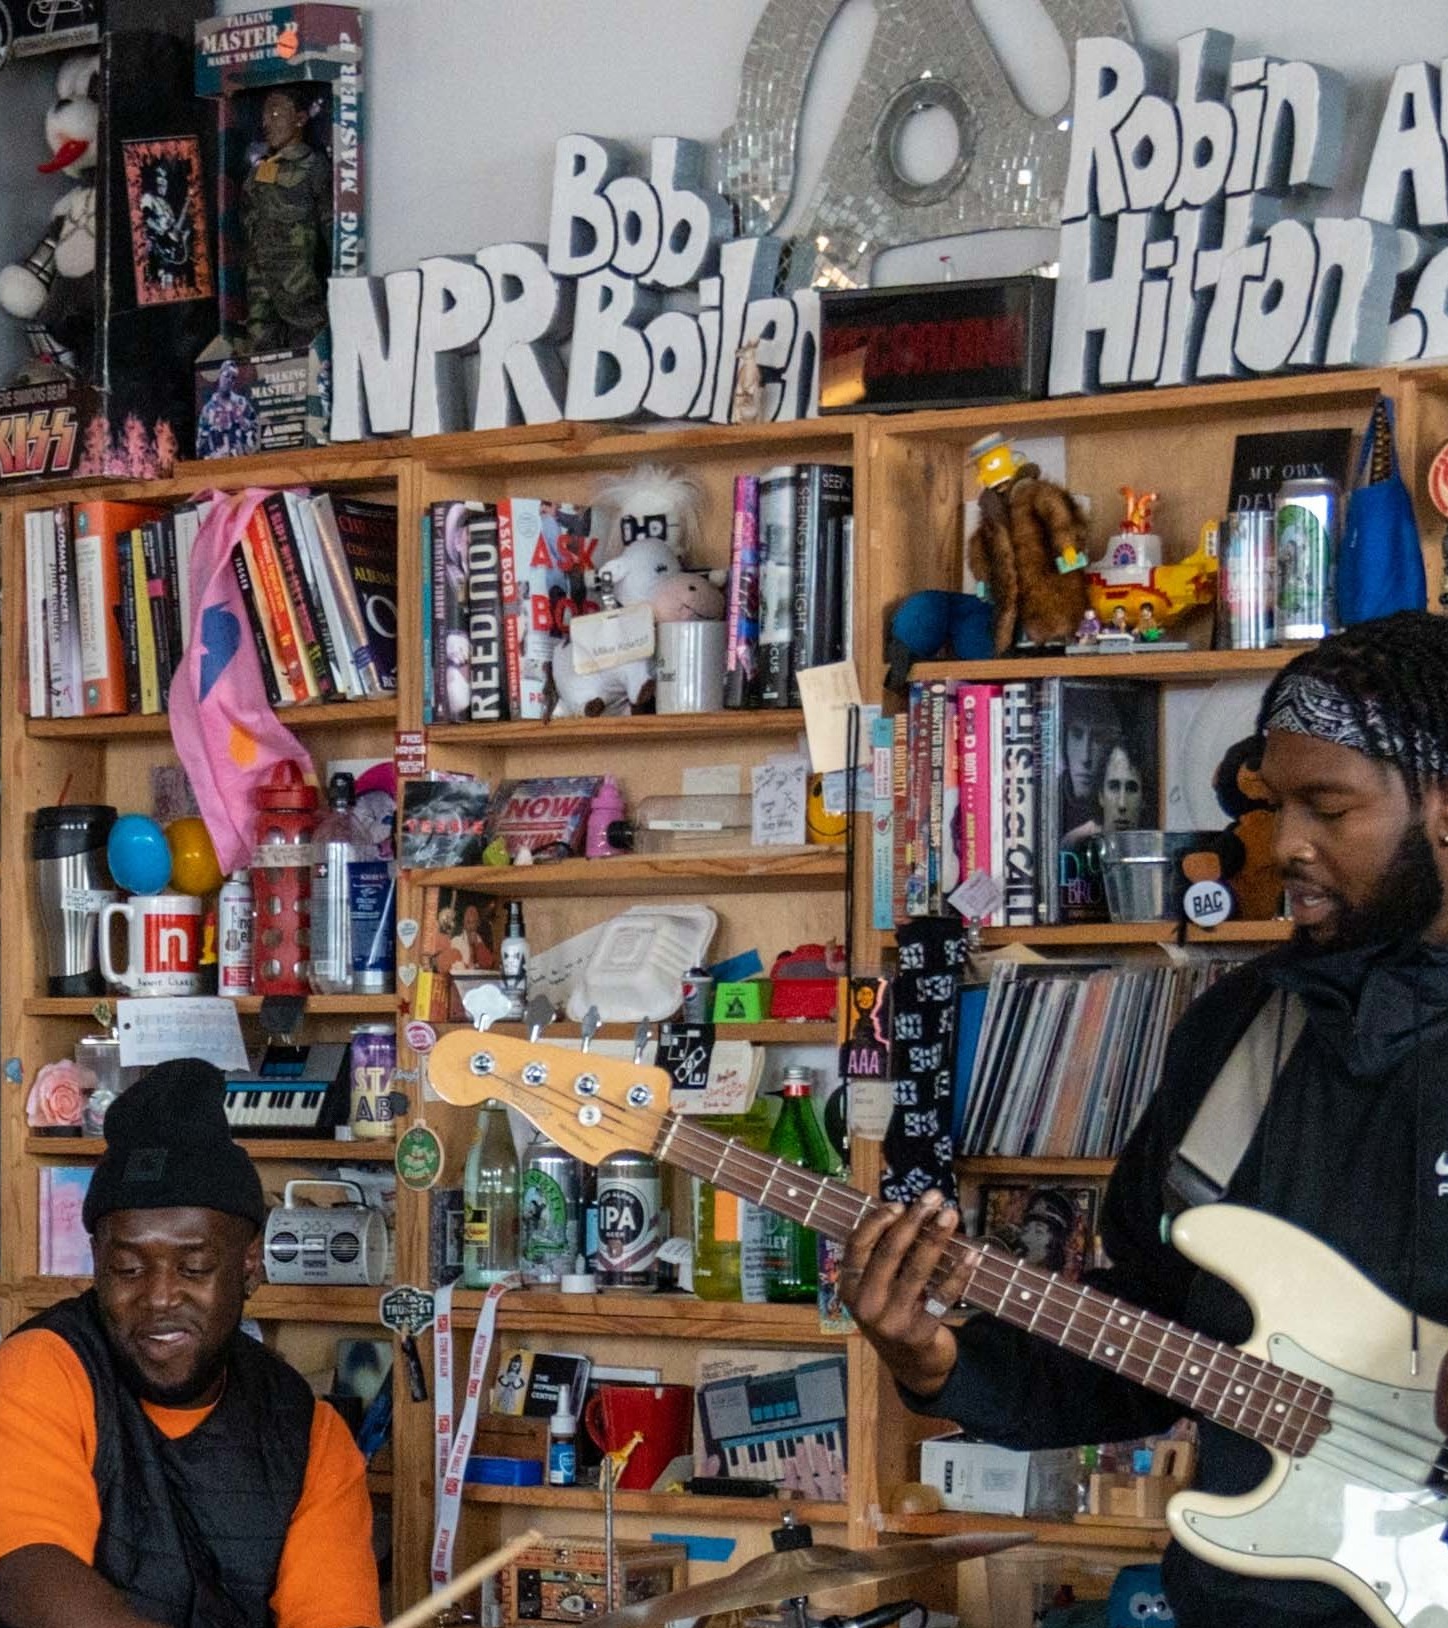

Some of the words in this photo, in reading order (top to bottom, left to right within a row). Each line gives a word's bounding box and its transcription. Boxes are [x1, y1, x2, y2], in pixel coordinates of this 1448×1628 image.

[203, 27, 277, 51] MASTER
[339, 64, 360, 196] MASTER
[1064, 31, 1322, 219] Robin
[549, 134, 711, 288] Bob
[1049, 195, 1377, 395] Hilton
[328, 242, 565, 440] NPR
[565, 236, 823, 422] Boilen
[1249, 464, 1274, 480] MY
[1282, 462, 1325, 478] OWN
[498, 514, 511, 552] ASK
[797, 486, 810, 546] SEEING
[56, 526, 68, 571] COSMIC
[531, 528, 600, 574] ASK
[58, 573, 69, 623] DANCER
[502, 557, 515, 598] BOB
[795, 582, 807, 634] LIGHT
[469, 616, 499, 721] REED
[893, 714, 907, 741] MIKE
[1005, 691, 1035, 771] THIS
[893, 745, 907, 798] DOUGHTY
[965, 752, 977, 784] BOOTY
[1005, 844, 1035, 927] CALL
[1192, 891, 1223, 912] BAC
[847, 1049, 880, 1074] AAA
[599, 1203, 636, 1229] IPA
